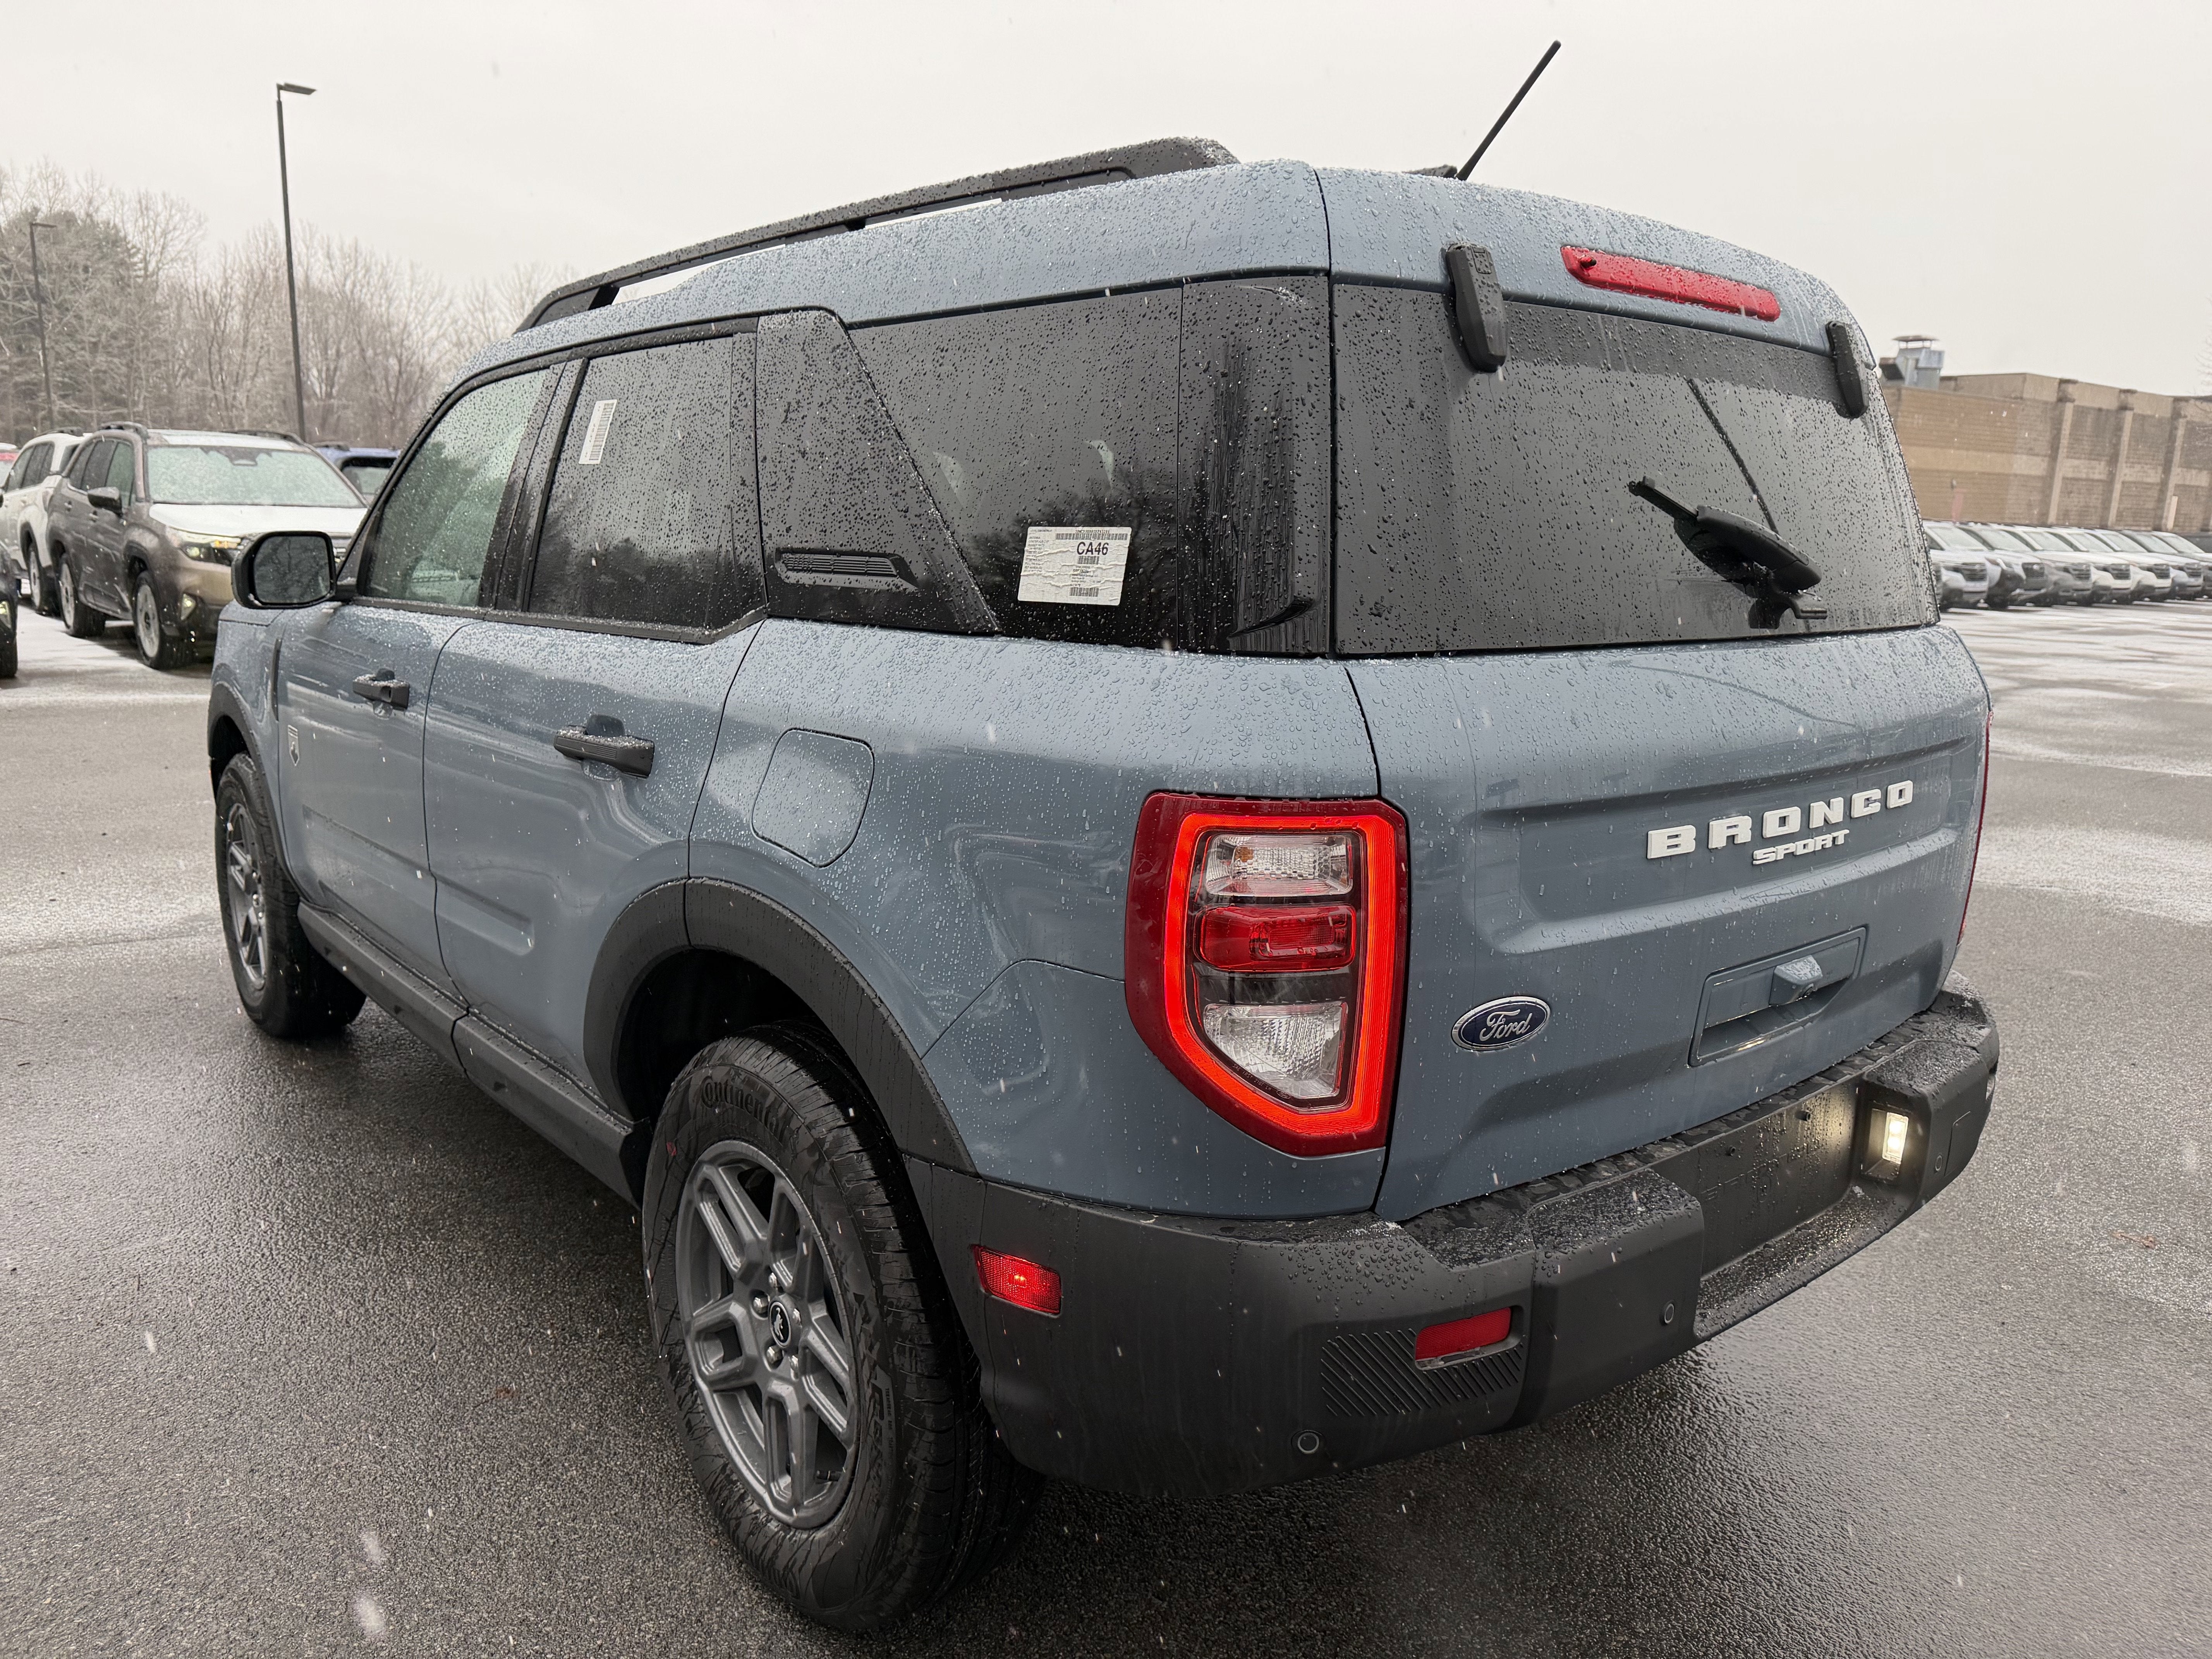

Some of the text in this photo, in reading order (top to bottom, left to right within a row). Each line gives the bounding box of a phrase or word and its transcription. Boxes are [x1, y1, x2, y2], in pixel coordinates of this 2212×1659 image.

[1077, 541, 1109, 555] CA46
[1647, 780, 1913, 859] BRONCO
[1752, 829, 1850, 865] SPORT
[1479, 1009, 1533, 1042] Ford
[701, 1075, 794, 1142] Continental
